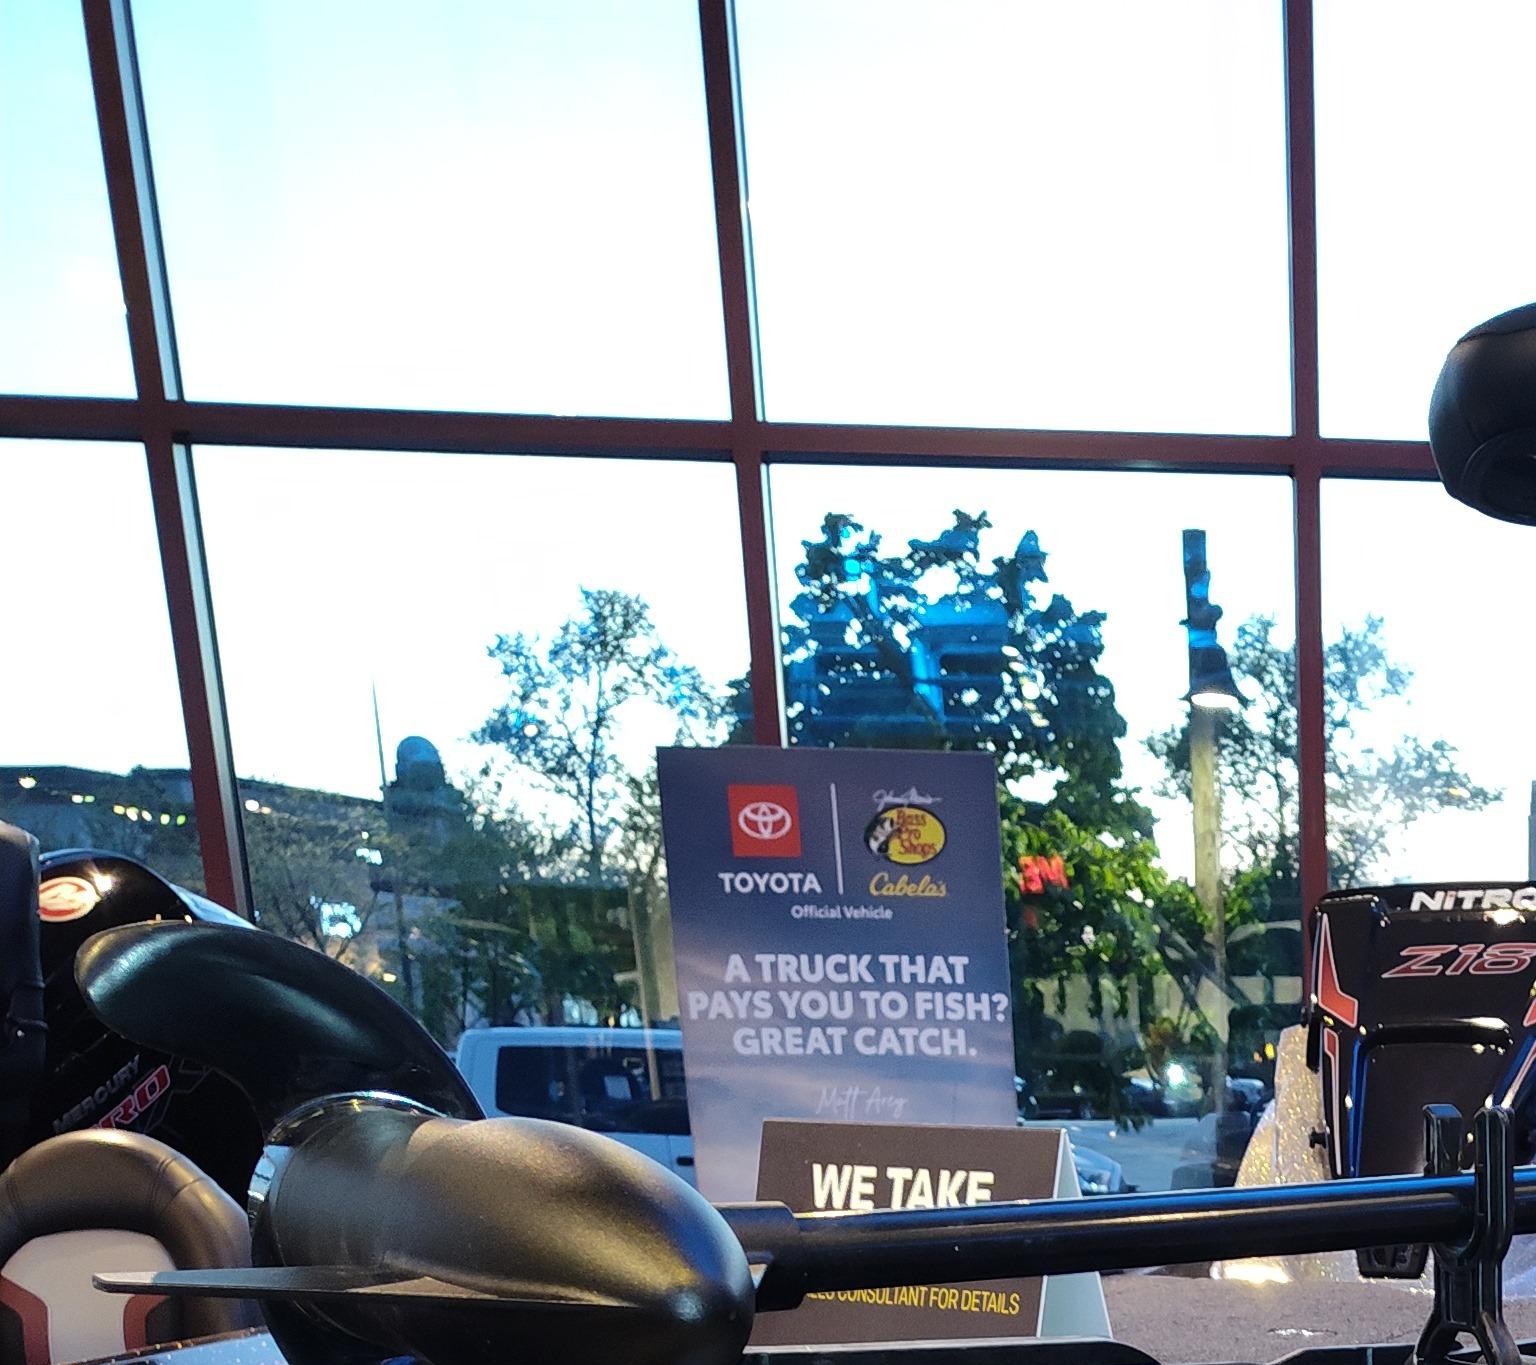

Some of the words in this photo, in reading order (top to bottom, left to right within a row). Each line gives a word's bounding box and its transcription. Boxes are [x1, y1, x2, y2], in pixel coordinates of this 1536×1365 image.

[718, 871, 822, 894] TOYOTA
[791, 903, 841, 919] Official
[842, 904, 893, 920] Vehicle
[725, 954, 752, 983] A
[754, 954, 875, 984] TRUCK
[879, 955, 969, 984] THAT
[688, 991, 774, 1021] PAYS
[776, 991, 857, 1021] YOU
[858, 992, 907, 1021] TO
[915, 992, 1008, 1023] FISH?
[732, 1026, 847, 1056] GREAT
[854, 1027, 978, 1056] CATCH.
[811, 1162, 878, 1211] WE
[886, 1166, 995, 1210] TAKE
[929, 1287, 958, 1310] FOR
[960, 1289, 1021, 1315] DETAILS
